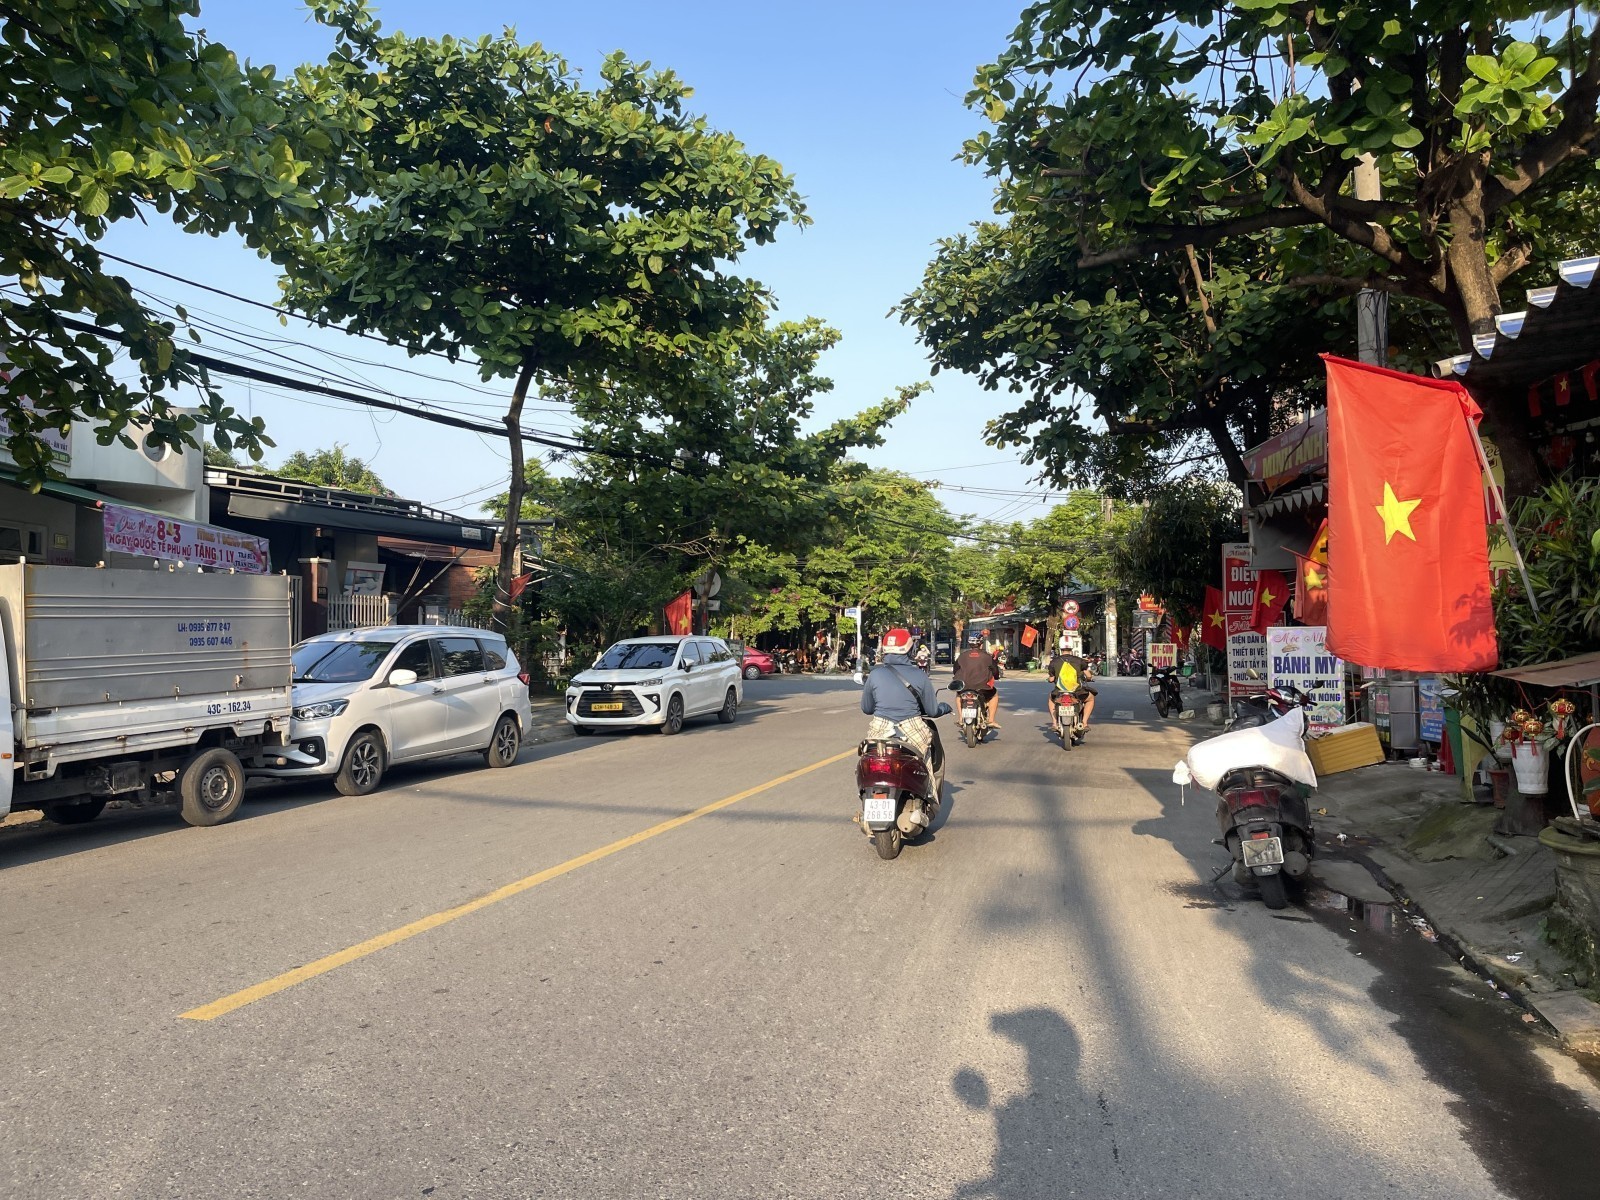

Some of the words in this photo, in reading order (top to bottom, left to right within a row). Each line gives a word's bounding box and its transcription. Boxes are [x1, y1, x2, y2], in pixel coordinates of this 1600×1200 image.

[158, 540, 166, 554] TẾ
[226, 550, 235, 563] LY
[1231, 563, 1259, 585] ĐIỆN
[1228, 588, 1256, 606] NƯỚ
[189, 623, 205, 632] 0935
[189, 638, 205, 646] 0935
[206, 637, 218, 646] 607
[1232, 646, 1248, 657] THIẾT
[1273, 653, 1311, 674] BÁNH
[207, 704, 221, 714] 43C
[228, 701, 251, 713] 162.34
